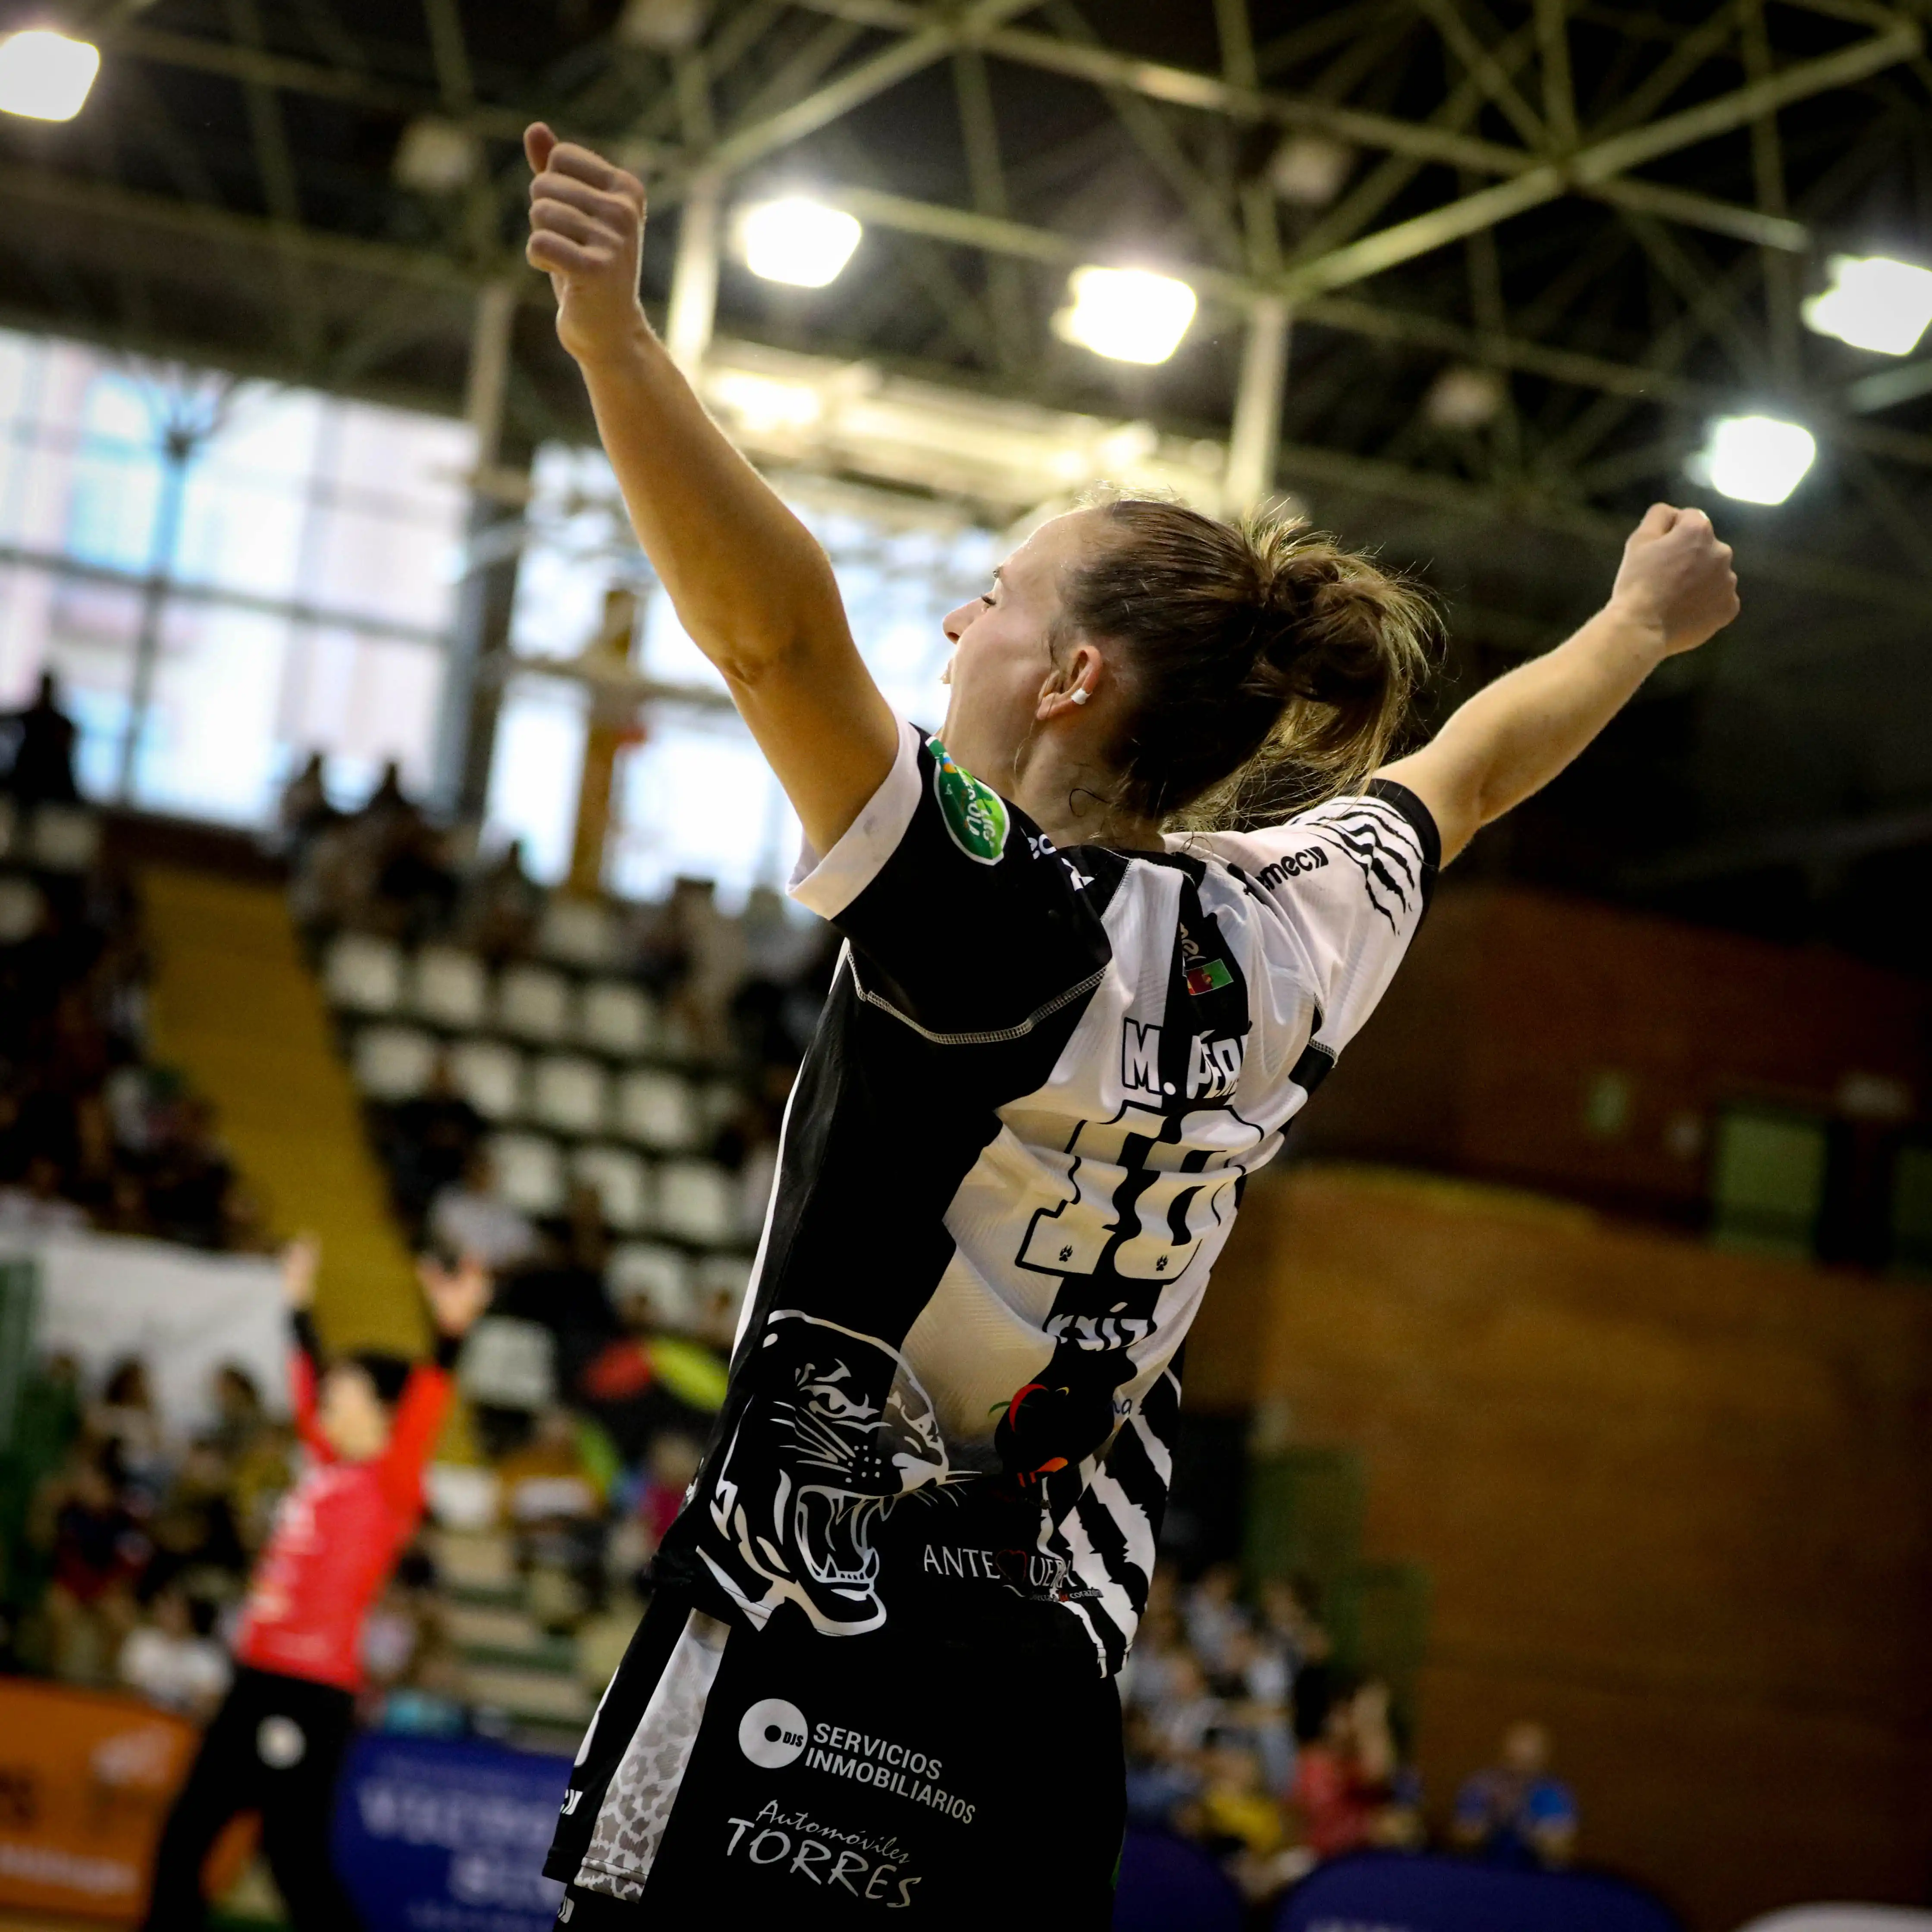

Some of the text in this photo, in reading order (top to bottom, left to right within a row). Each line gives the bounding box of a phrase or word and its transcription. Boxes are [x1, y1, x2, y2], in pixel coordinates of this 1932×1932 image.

[1123, 1018, 1176, 1095] M.
[783, 1731, 804, 1747] DJS
[813, 1723, 942, 1780] SERVICIOS
[805, 1747, 975, 1824] INMOBILIARIOS
[727, 1817, 922, 1908] TORRES
[756, 1799, 910, 1864] Automóviles
